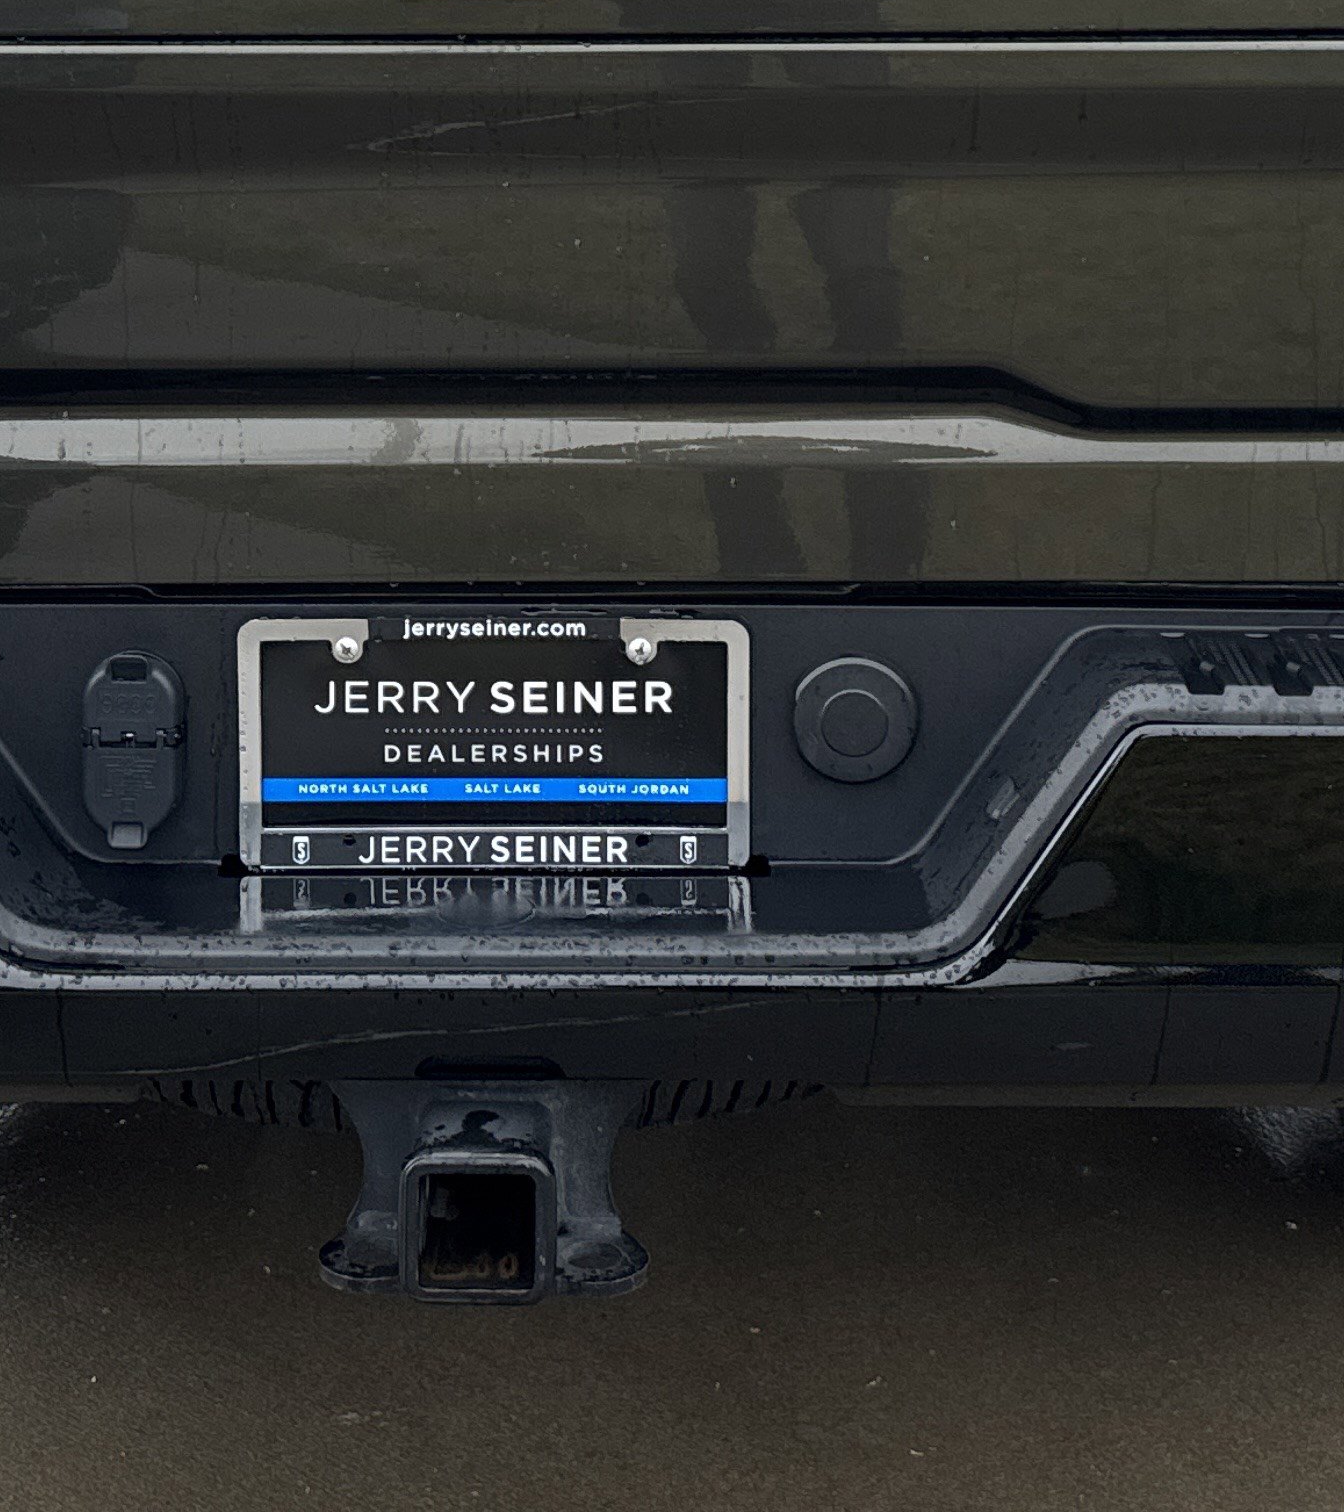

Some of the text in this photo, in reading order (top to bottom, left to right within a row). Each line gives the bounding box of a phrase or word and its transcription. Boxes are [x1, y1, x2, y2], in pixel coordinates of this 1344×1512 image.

[403, 619, 585, 639] jerryseiner.com
[314, 681, 672, 713] JERRY SEINER
[385, 745, 602, 762] DEALERSHIPS
[298, 783, 429, 794] NORTH SALT LAKE
[464, 783, 541, 794] SALT LAKE
[578, 784, 689, 795] SOUTH JORDAN
[359, 836, 627, 863] JERRY SEINER
